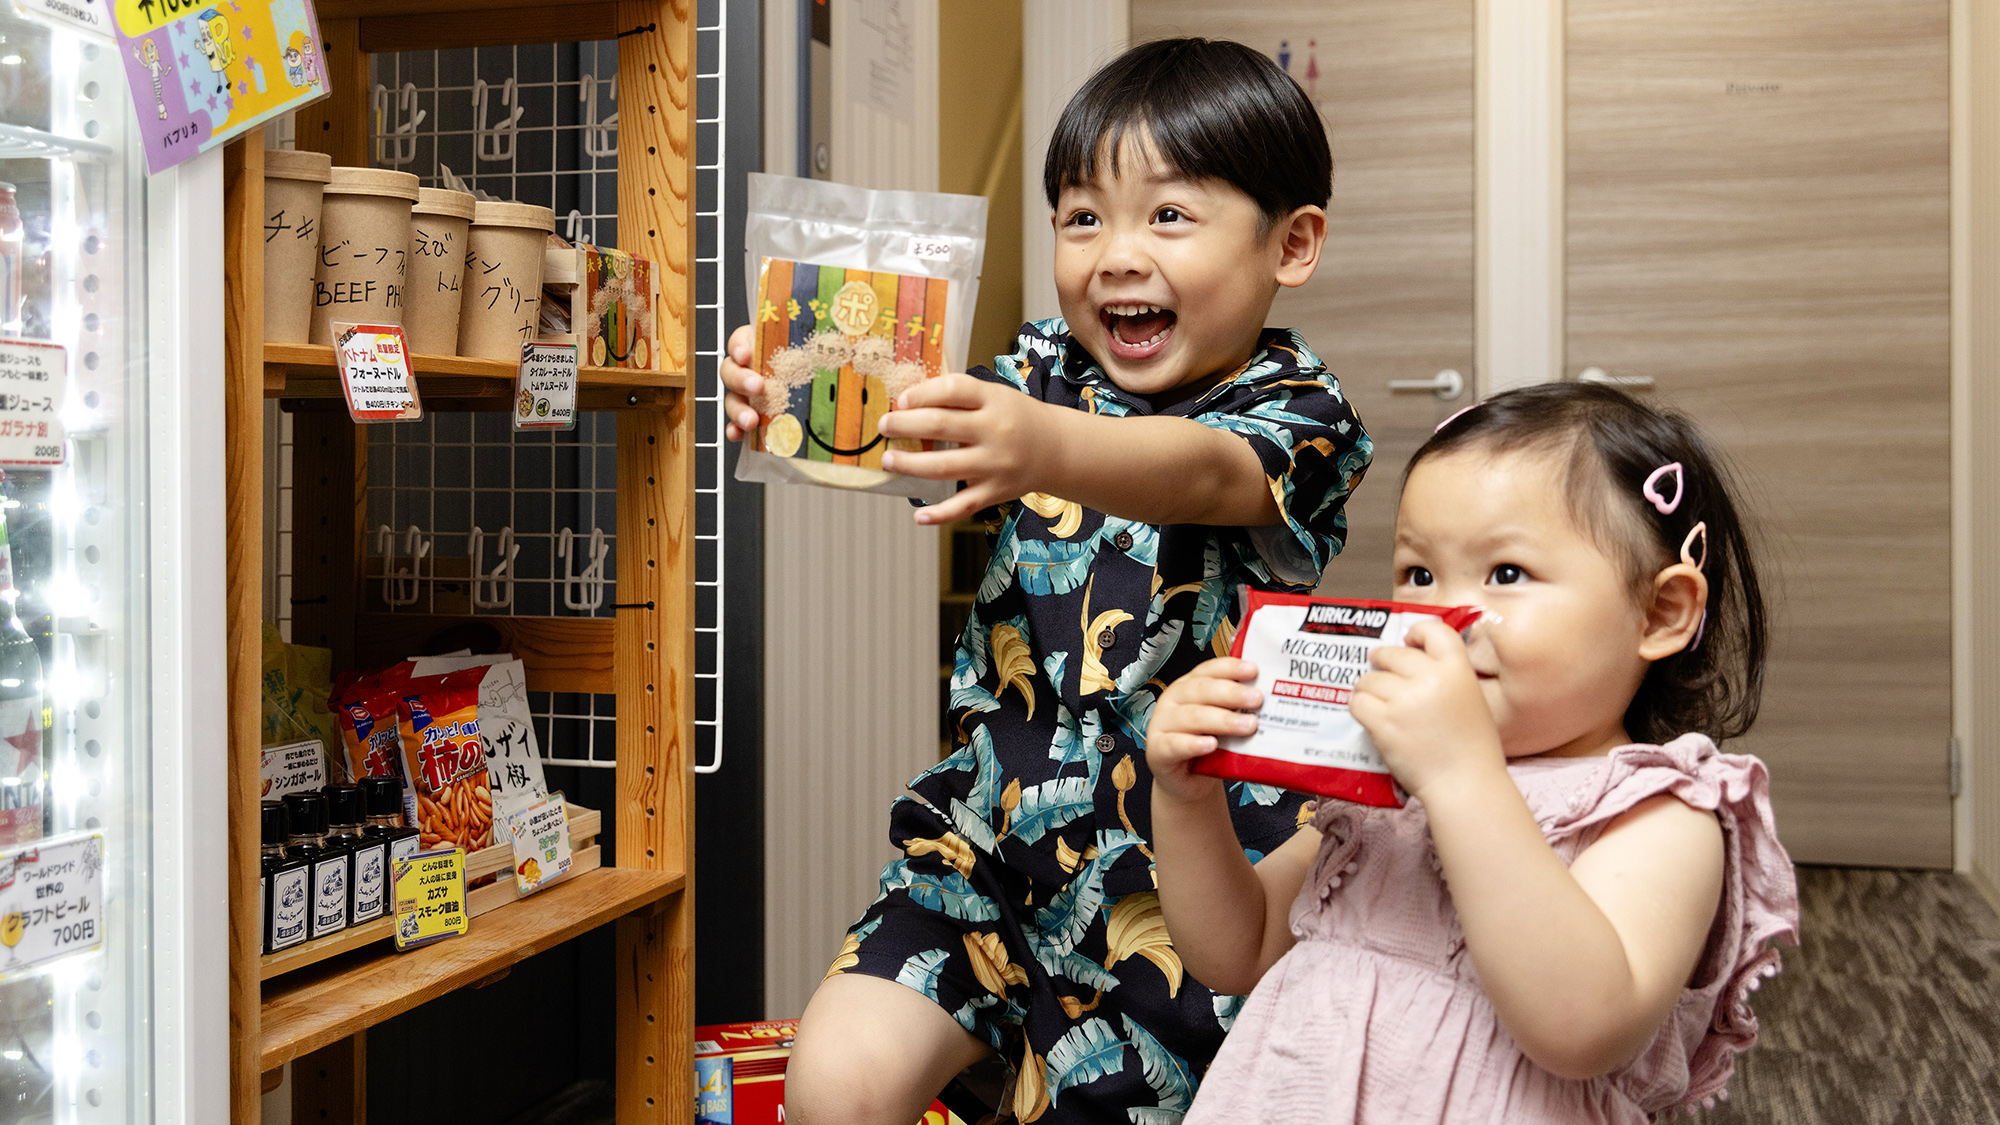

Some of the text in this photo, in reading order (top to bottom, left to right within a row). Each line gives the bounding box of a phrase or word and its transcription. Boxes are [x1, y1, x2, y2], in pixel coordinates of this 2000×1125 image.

[264, 209, 319, 248] チキ
[415, 229, 453, 257] えび
[913, 242, 951, 256] ¥500
[316, 280, 377, 307] BEEF
[343, 348, 378, 363] ベトナム
[350, 367, 402, 380] フォーヌードル
[529, 367, 573, 378] タイカレーヌードル
[530, 381, 570, 391] トムヤムヌードル
[35, 445, 60, 458] 200円
[1307, 605, 1389, 629] KIRKLAND
[1274, 681, 1301, 697] MOVIE
[1300, 684, 1337, 701] THEATER
[424, 719, 479, 743] カリッと! 亀
[417, 739, 487, 792] 柿の
[275, 769, 322, 790] シンガポール
[538, 831, 560, 851] スナック
[23, 860, 77, 883] ワールドワイド
[421, 859, 454, 872] どんな料理も
[36, 881, 64, 899] 世界の
[427, 886, 448, 901] カズサ
[8, 895, 91, 932] クラフトビール
[444, 916, 462, 927] 800円
[53, 919, 95, 946] 700円
[707, 1098, 727, 1114] BAGS
